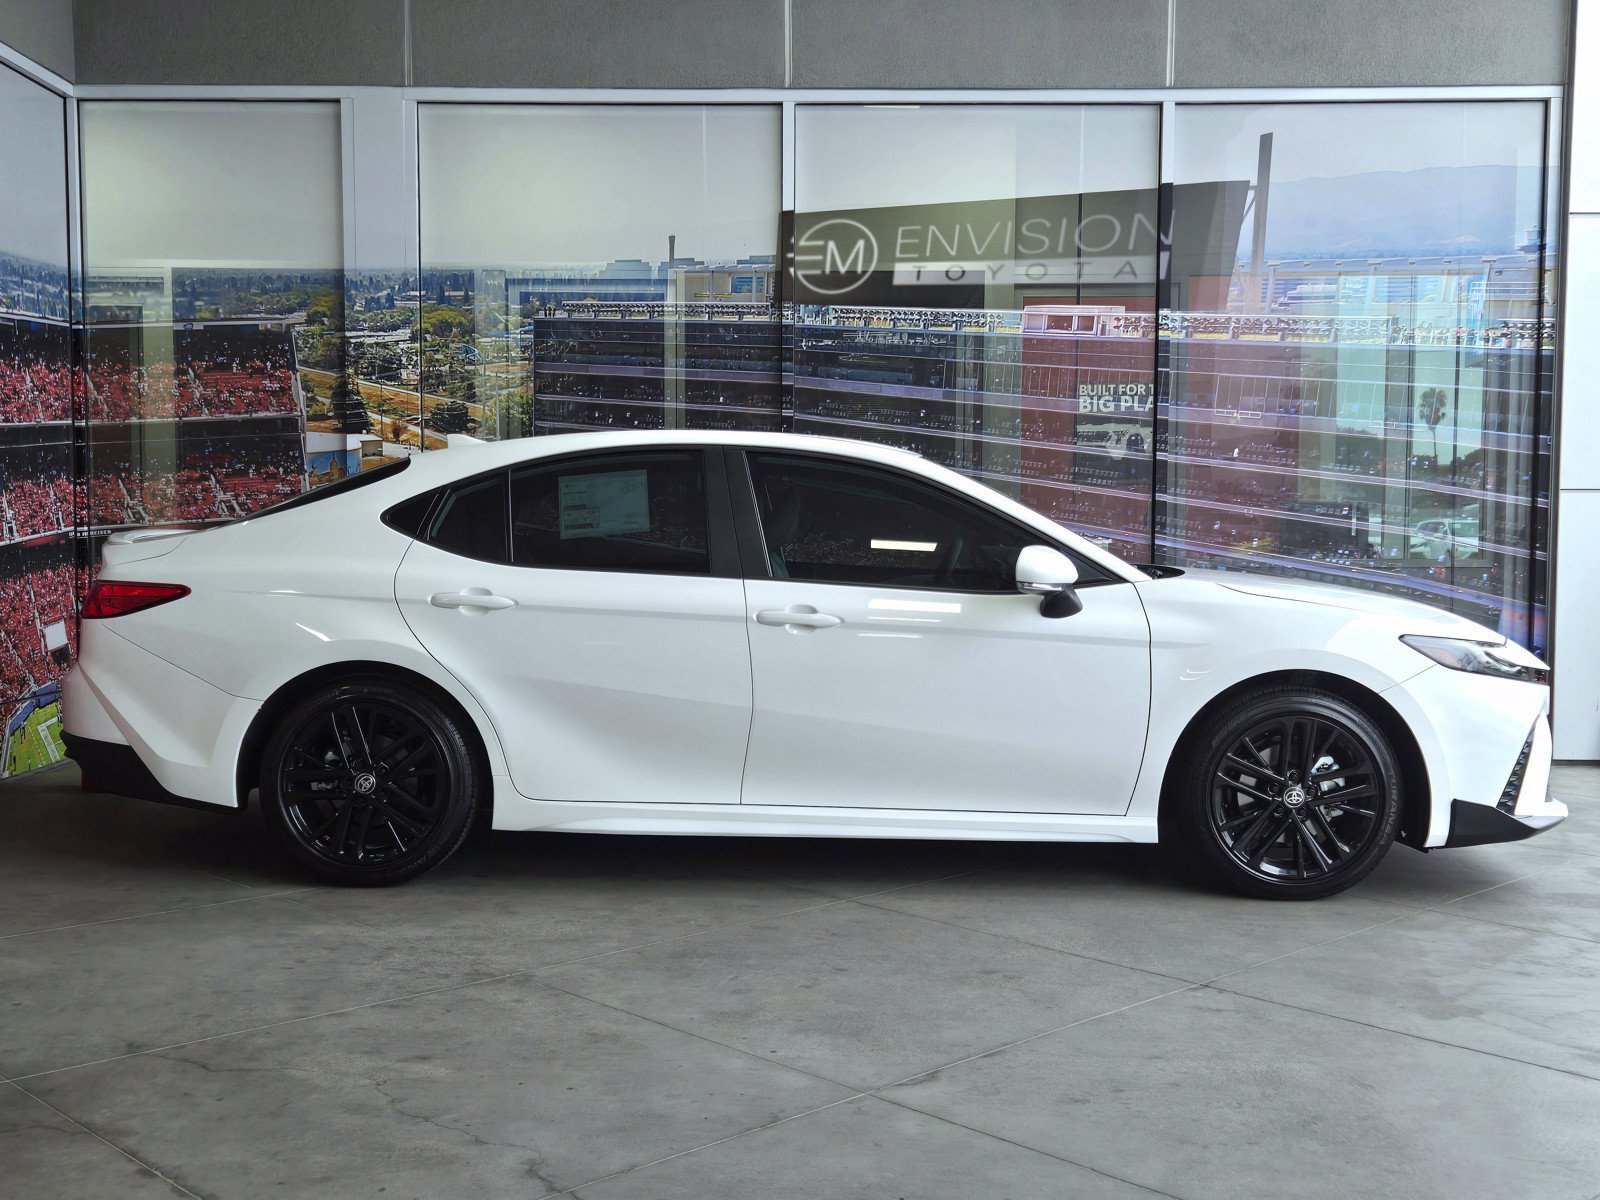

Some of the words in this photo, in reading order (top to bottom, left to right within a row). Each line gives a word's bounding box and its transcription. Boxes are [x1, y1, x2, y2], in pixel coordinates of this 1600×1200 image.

[895, 209, 1175, 258] ENVISION
[911, 259, 1138, 282] TOYOTA
[1079, 384, 1116, 396] BUILT
[1119, 384, 1146, 395] FOR
[1079, 396, 1115, 413] BIG
